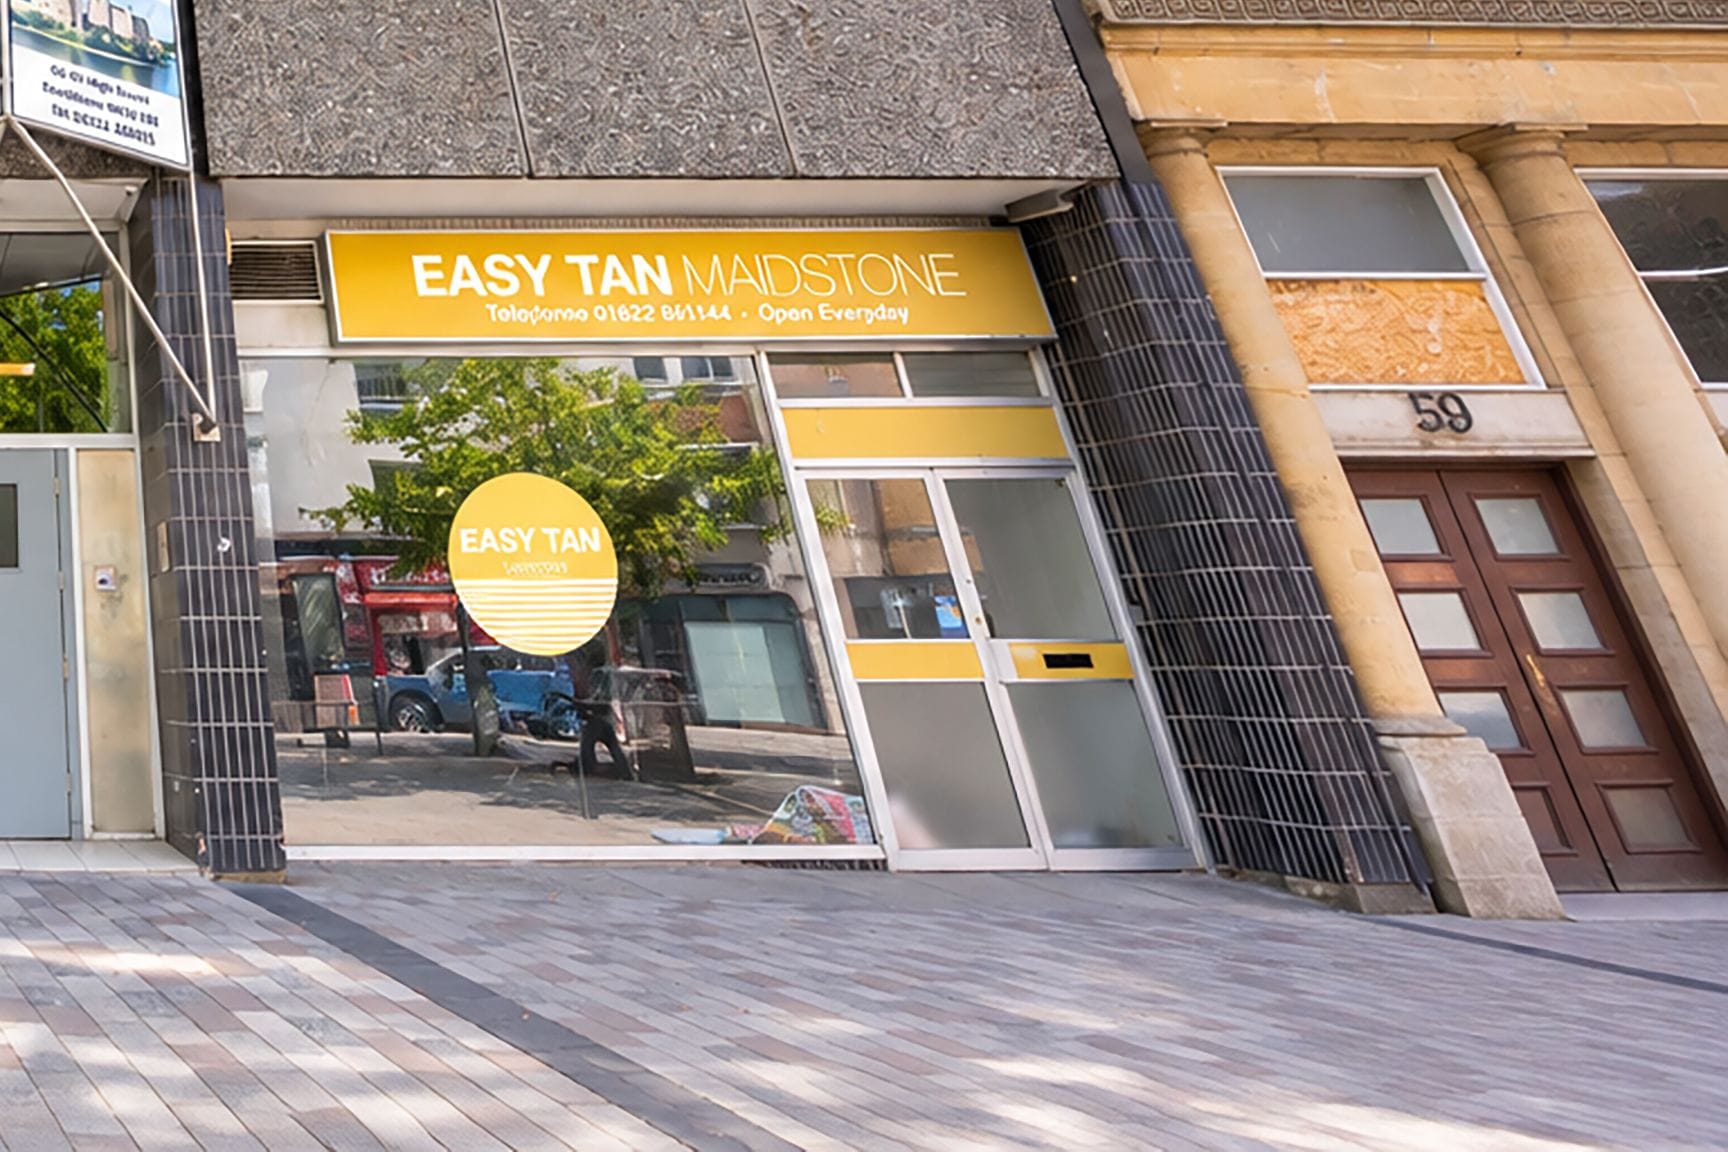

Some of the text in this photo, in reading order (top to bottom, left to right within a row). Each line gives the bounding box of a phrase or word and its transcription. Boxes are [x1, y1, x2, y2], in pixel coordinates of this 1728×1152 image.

[411, 253, 967, 297] EASY TAN MAIDSTONE
[1408, 392, 1473, 434] 59
[459, 526, 602, 555] EASY TAN
